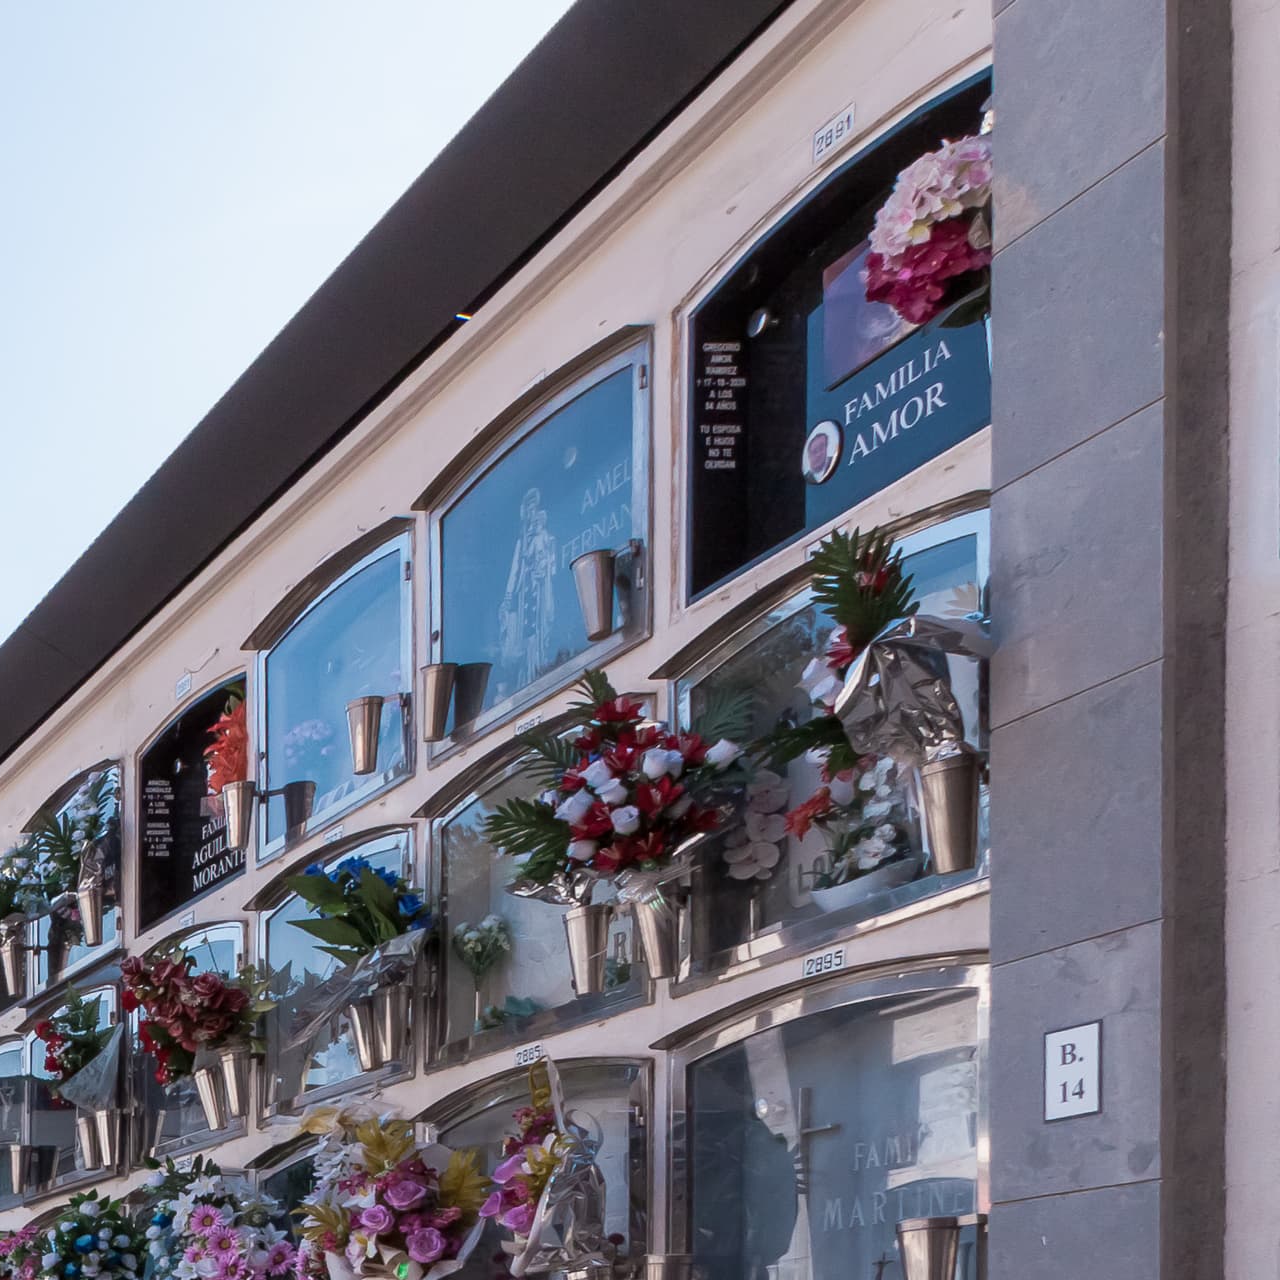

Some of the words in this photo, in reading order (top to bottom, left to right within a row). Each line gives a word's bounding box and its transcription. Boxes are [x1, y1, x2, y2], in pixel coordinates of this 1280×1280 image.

[815, 114, 852, 156] 2891
[844, 340, 952, 426] FAMILIA
[848, 382, 948, 466] AMOR
[805, 949, 844, 976] 2895
[516, 1044, 541, 1066] 2885
[1059, 1042, 1085, 1067] B.
[1059, 1077, 1086, 1104] 14
